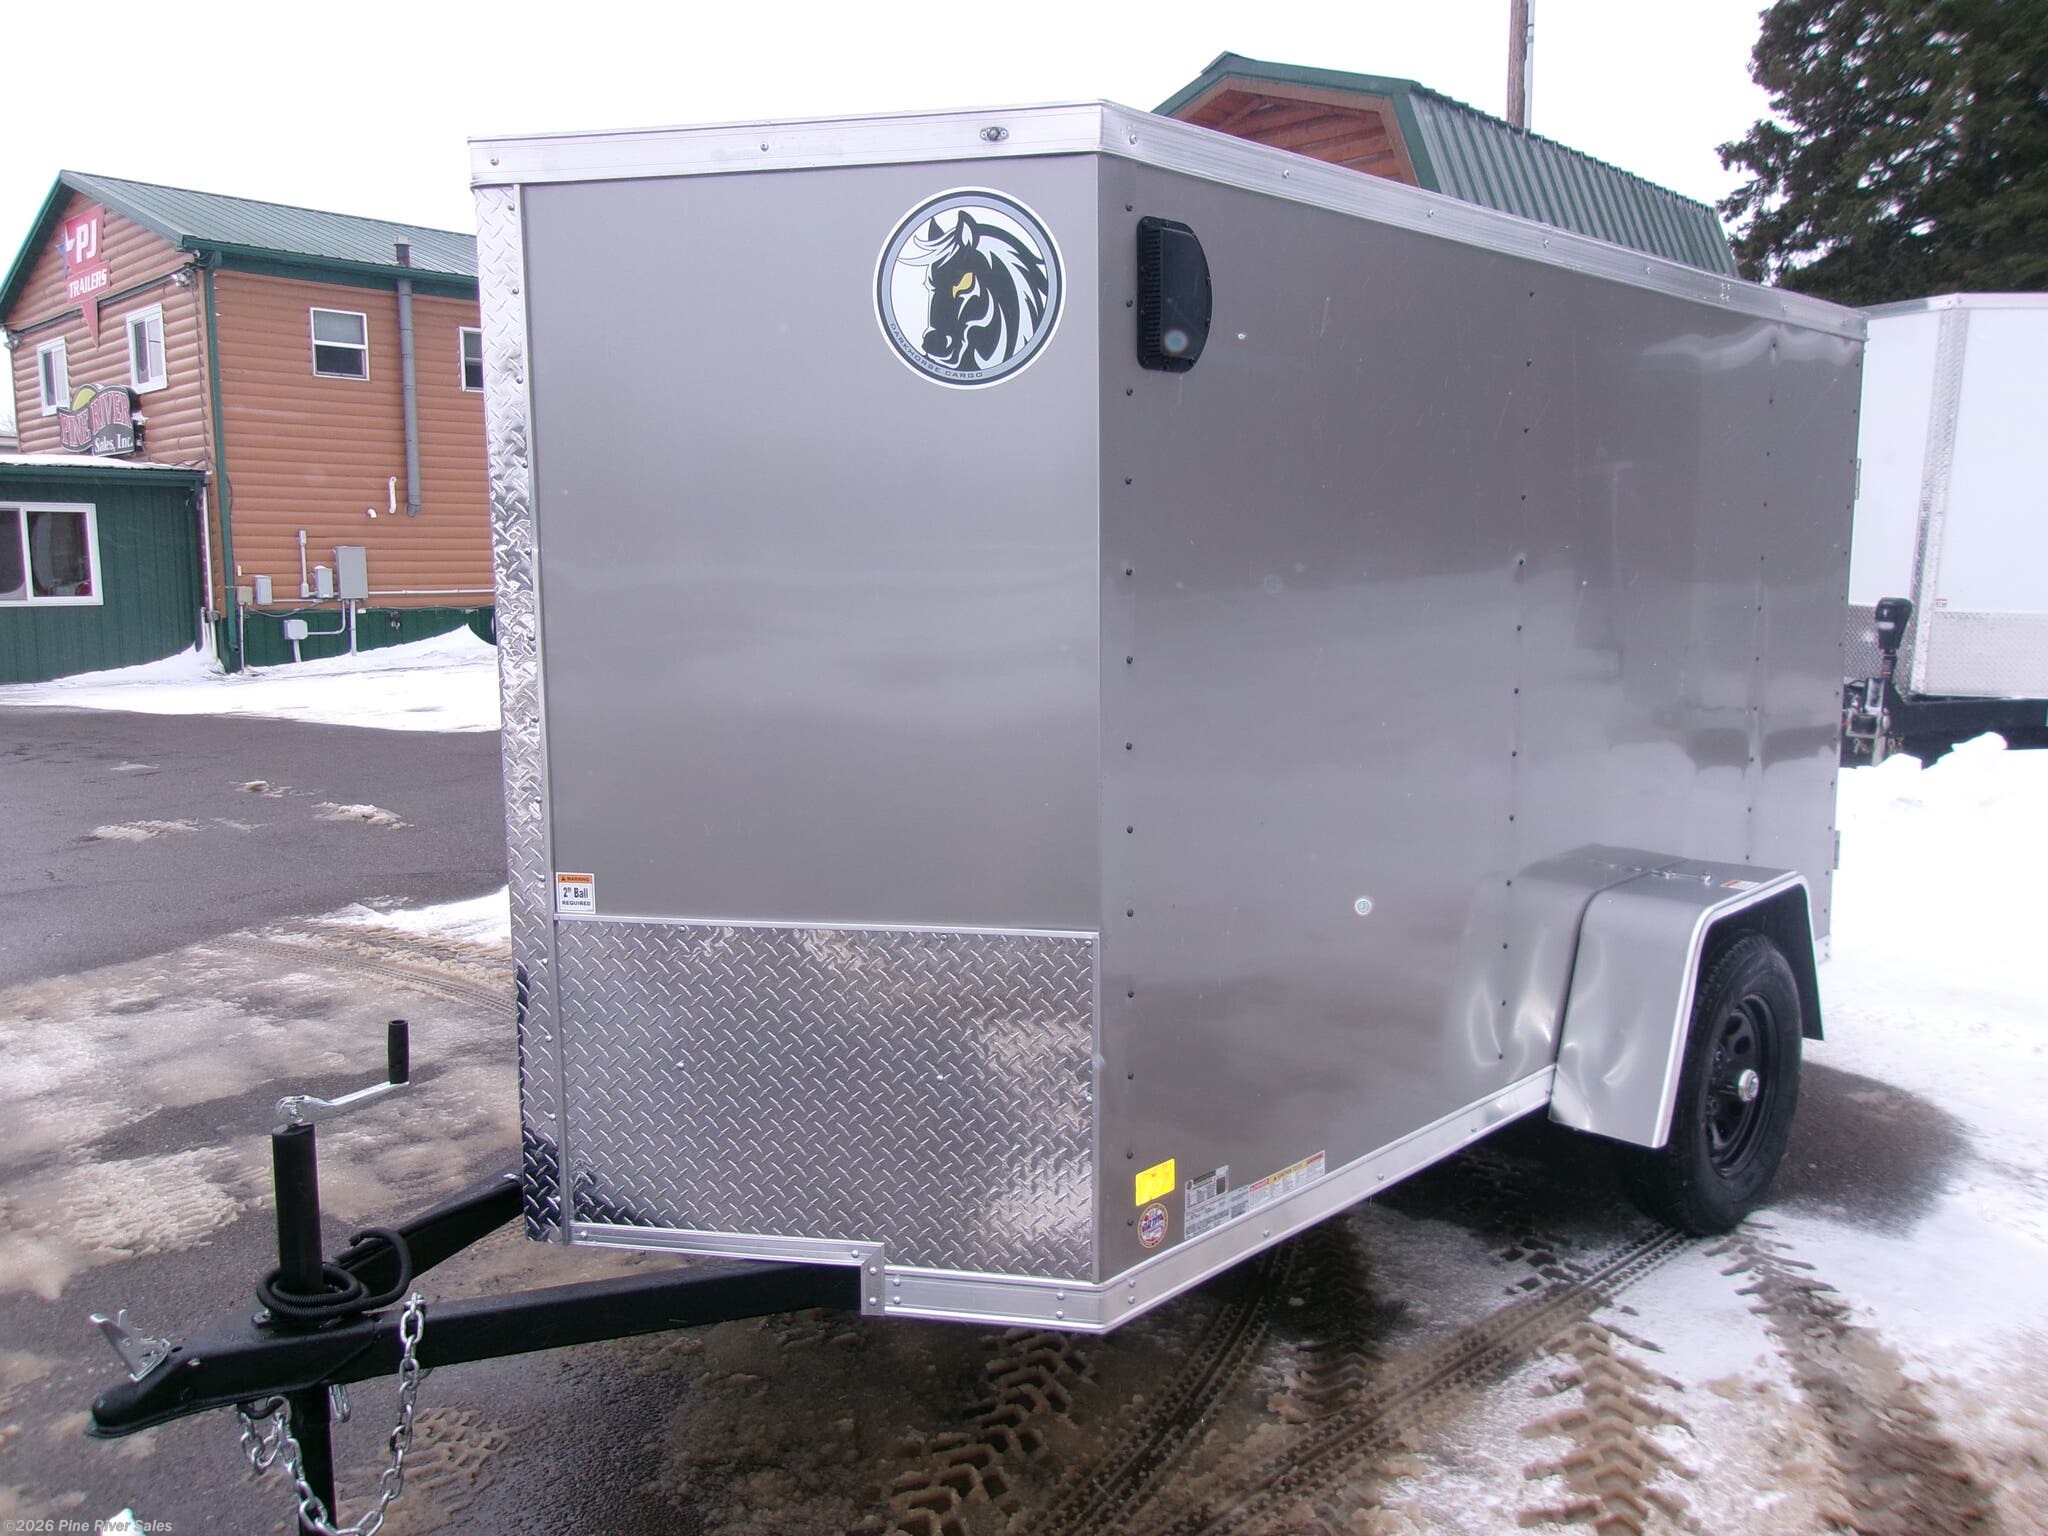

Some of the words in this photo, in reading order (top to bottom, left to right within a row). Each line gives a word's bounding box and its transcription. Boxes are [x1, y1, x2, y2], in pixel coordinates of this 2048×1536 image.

[76, 218, 97, 264] PJ
[69, 268, 108, 299] TRAILERS
[890, 322, 942, 374] DARKHORSE
[944, 370, 983, 379] CARGO
[59, 407, 92, 447] PINE
[90, 390, 133, 436] RIVER
[94, 435, 116, 453] Sales,
[117, 433, 134, 449] Inc.
[563, 887, 571, 898] 2"
[574, 887, 589, 898] Ball
